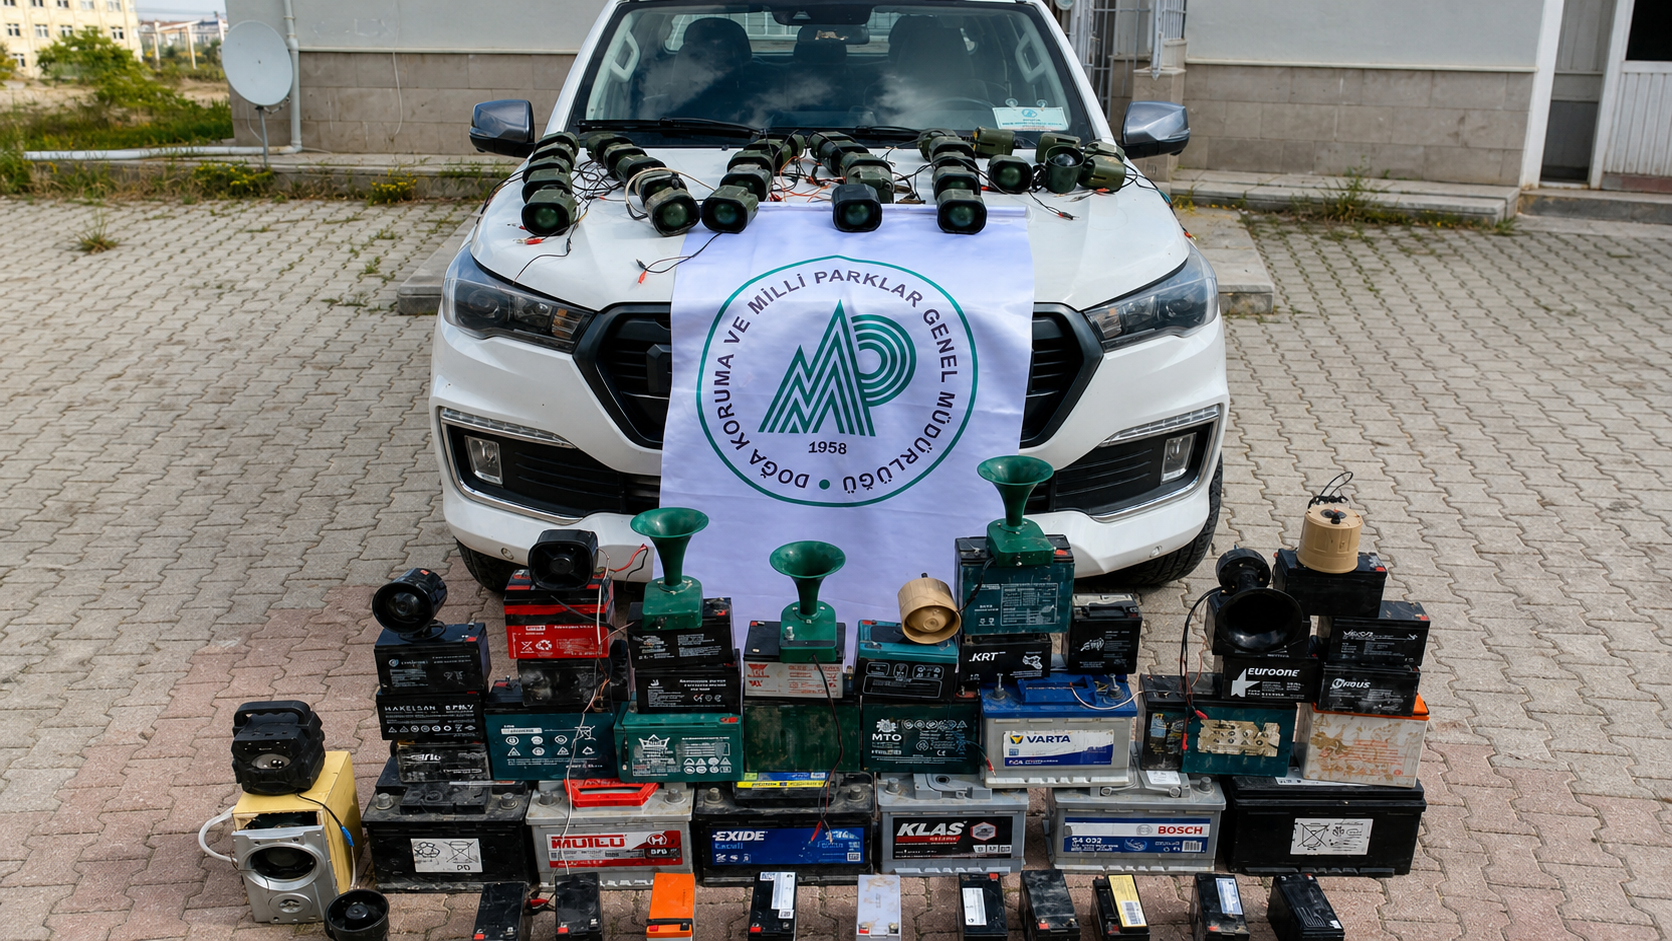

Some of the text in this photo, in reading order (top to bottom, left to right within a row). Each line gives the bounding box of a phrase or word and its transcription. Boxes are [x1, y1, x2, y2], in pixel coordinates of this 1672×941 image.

[713, 269, 958, 494] DOĞA KORUMA VE MİLLİ PARKLAR GENEL MÜDÜRLÜĞÜ
[808, 441, 847, 454] 1958
[872, 733, 902, 741] MTO
[1026, 735, 1071, 743] VARTA
[897, 822, 965, 836] KLAS
[1158, 826, 1203, 834] BOSCH
[714, 831, 765, 841] EXIDE
